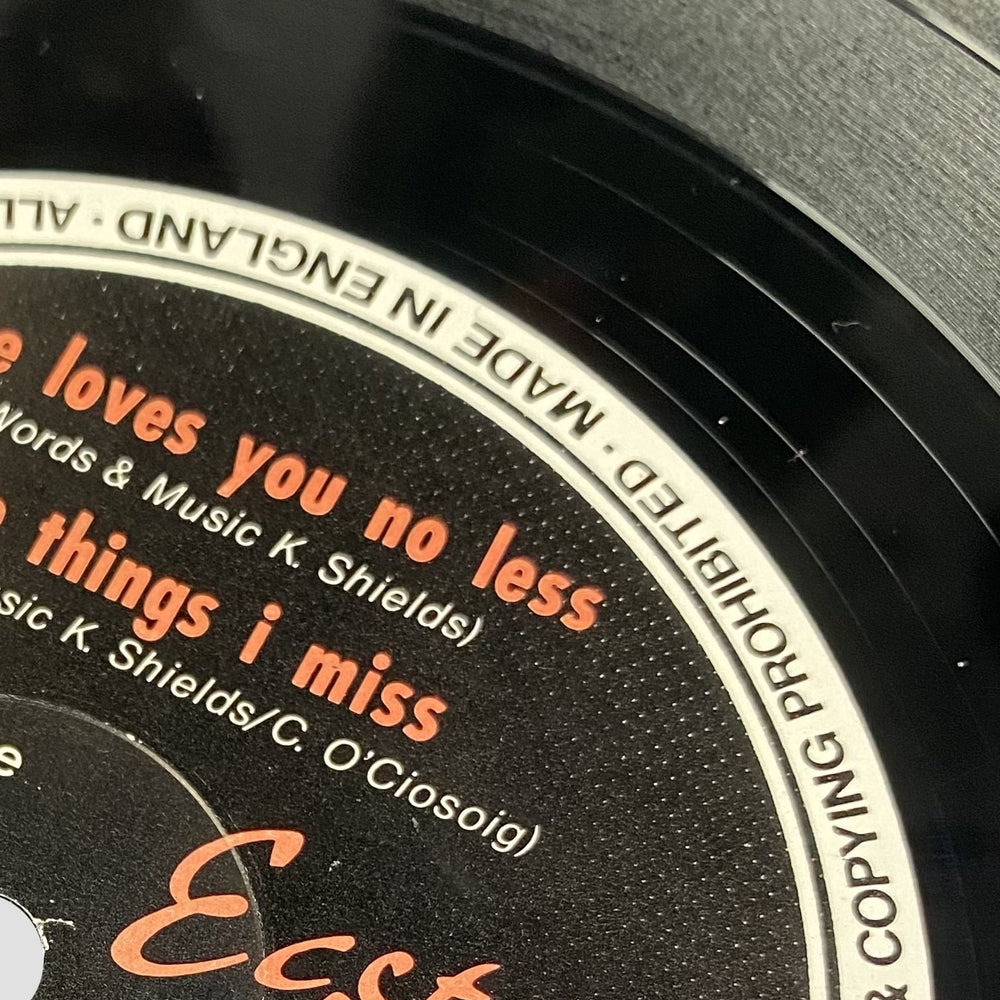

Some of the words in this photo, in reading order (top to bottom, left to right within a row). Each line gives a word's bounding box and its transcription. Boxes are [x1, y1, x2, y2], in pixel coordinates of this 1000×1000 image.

[118, 207, 383, 303] ENGLAND
[387, 286, 451, 334] IN
[454, 320, 605, 439] MADE
[42, 334, 206, 455] loves
[216, 433, 348, 515] you
[364, 495, 448, 563] no
[472, 522, 606, 632] less
[103, 457, 134, 489] &
[142, 473, 262, 547] Music
[269, 532, 309, 570] K.
[317, 552, 484, 648] Shields)
[26, 509, 219, 642] things
[239, 603, 283, 664] i
[291, 642, 448, 742] miss
[59, 615, 98, 653] K.
[615, 458, 824, 721] PROHIBITED
[800, 731, 902, 965] COPYING
